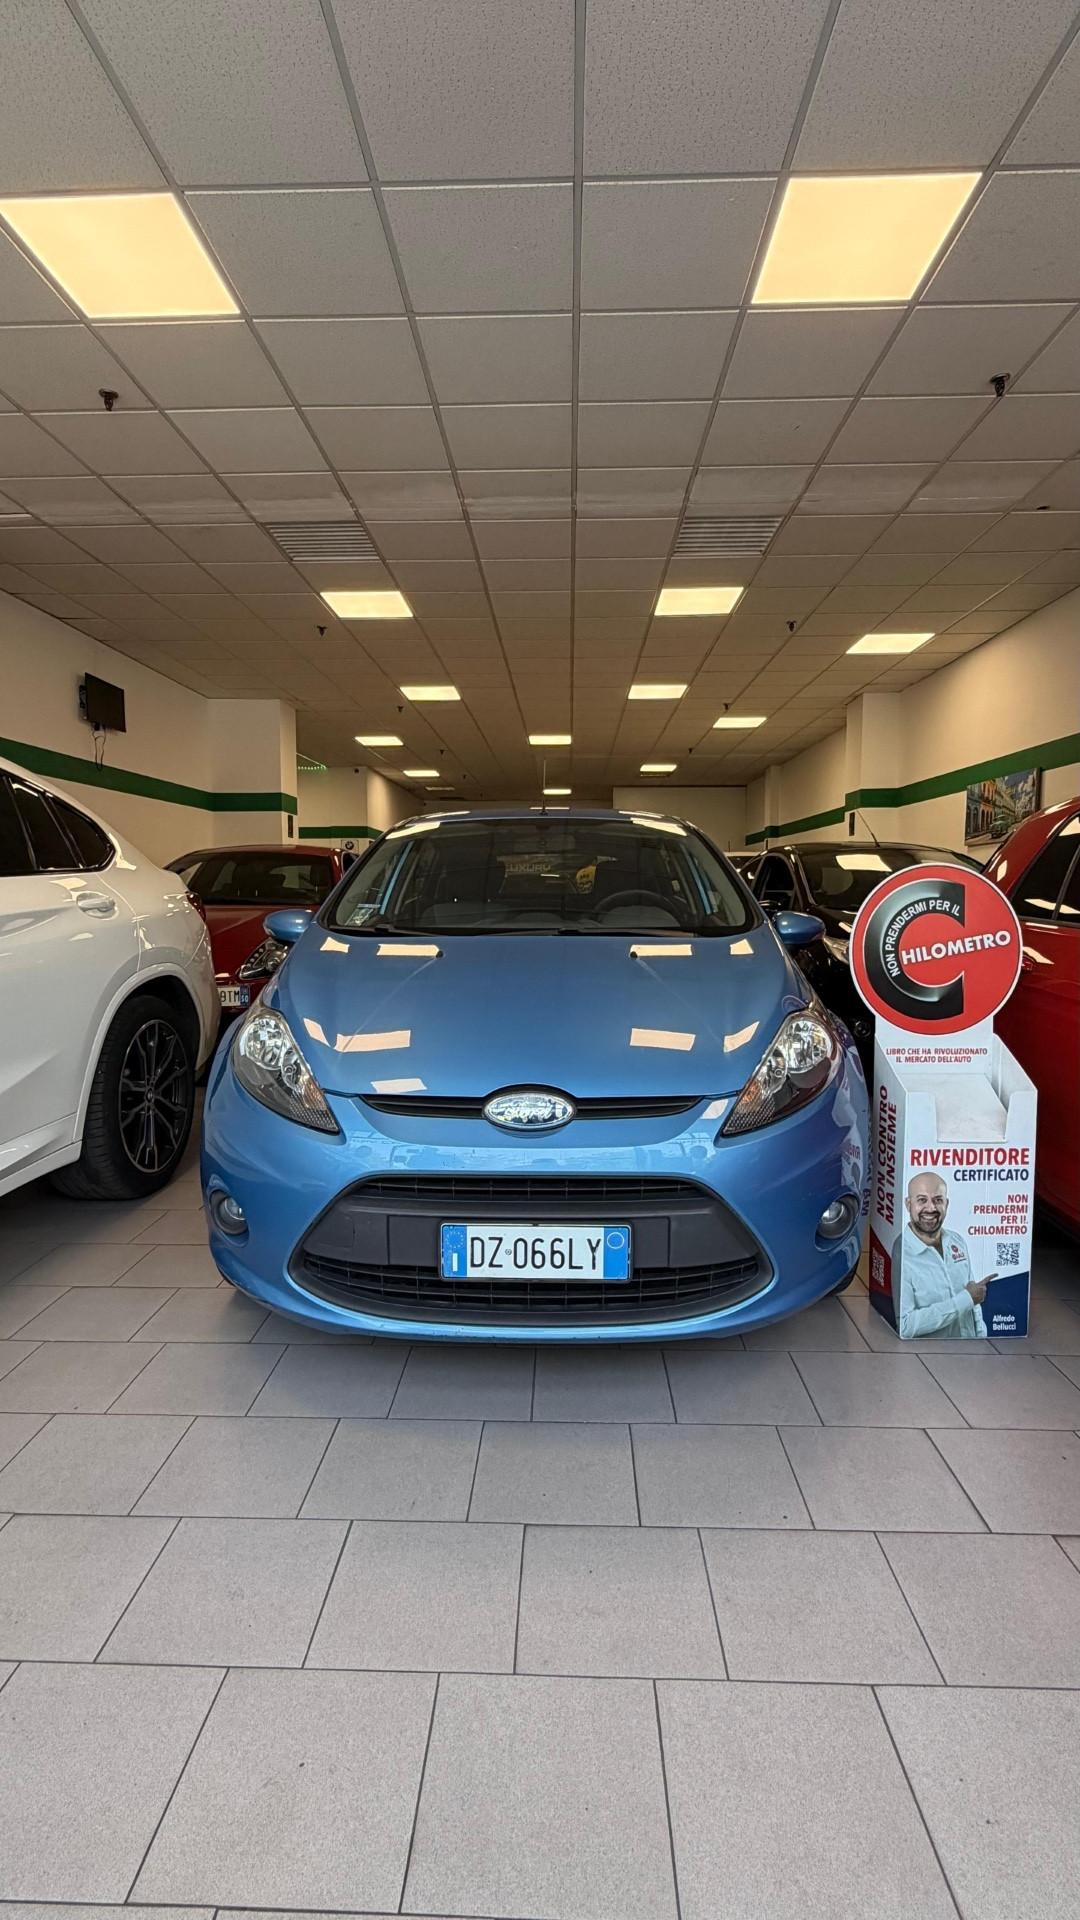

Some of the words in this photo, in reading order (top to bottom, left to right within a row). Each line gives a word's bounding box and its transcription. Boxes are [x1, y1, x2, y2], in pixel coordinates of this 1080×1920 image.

[928, 899, 950, 912] PER
[951, 904, 961, 917] IL
[885, 901, 927, 951] PRENDERMI
[885, 953, 901, 978] NON
[886, 1048, 905, 1056] LIBRO
[907, 1048, 921, 1056] CHE
[921, 1048, 932, 1056] HA
[934, 1047, 988, 1055] RIVOLUZIONATO
[937, 1055, 972, 1063] DELL'AUTO
[878, 1085, 888, 1164] CONTRO
[886, 1102, 897, 1188] INSIEME
[910, 1148, 1030, 1166] RIVENDITORE
[953, 1169, 1029, 1182] CERTIFICATO
[876, 1174, 886, 1217] NON
[1007, 1194, 1028, 1204] NON
[884, 1192, 895, 1225] MA
[973, 1204, 1028, 1214] PRENDERMI
[1000, 1215, 1018, 1225] PER
[967, 1225, 1028, 1235] CHILOMETRO
[470, 1236, 503, 1268] DZ
[513, 1238, 601, 1270] 066LY
[992, 1314, 1015, 1323] Alfredo
[992, 1323, 1016, 1331] Bellucci
